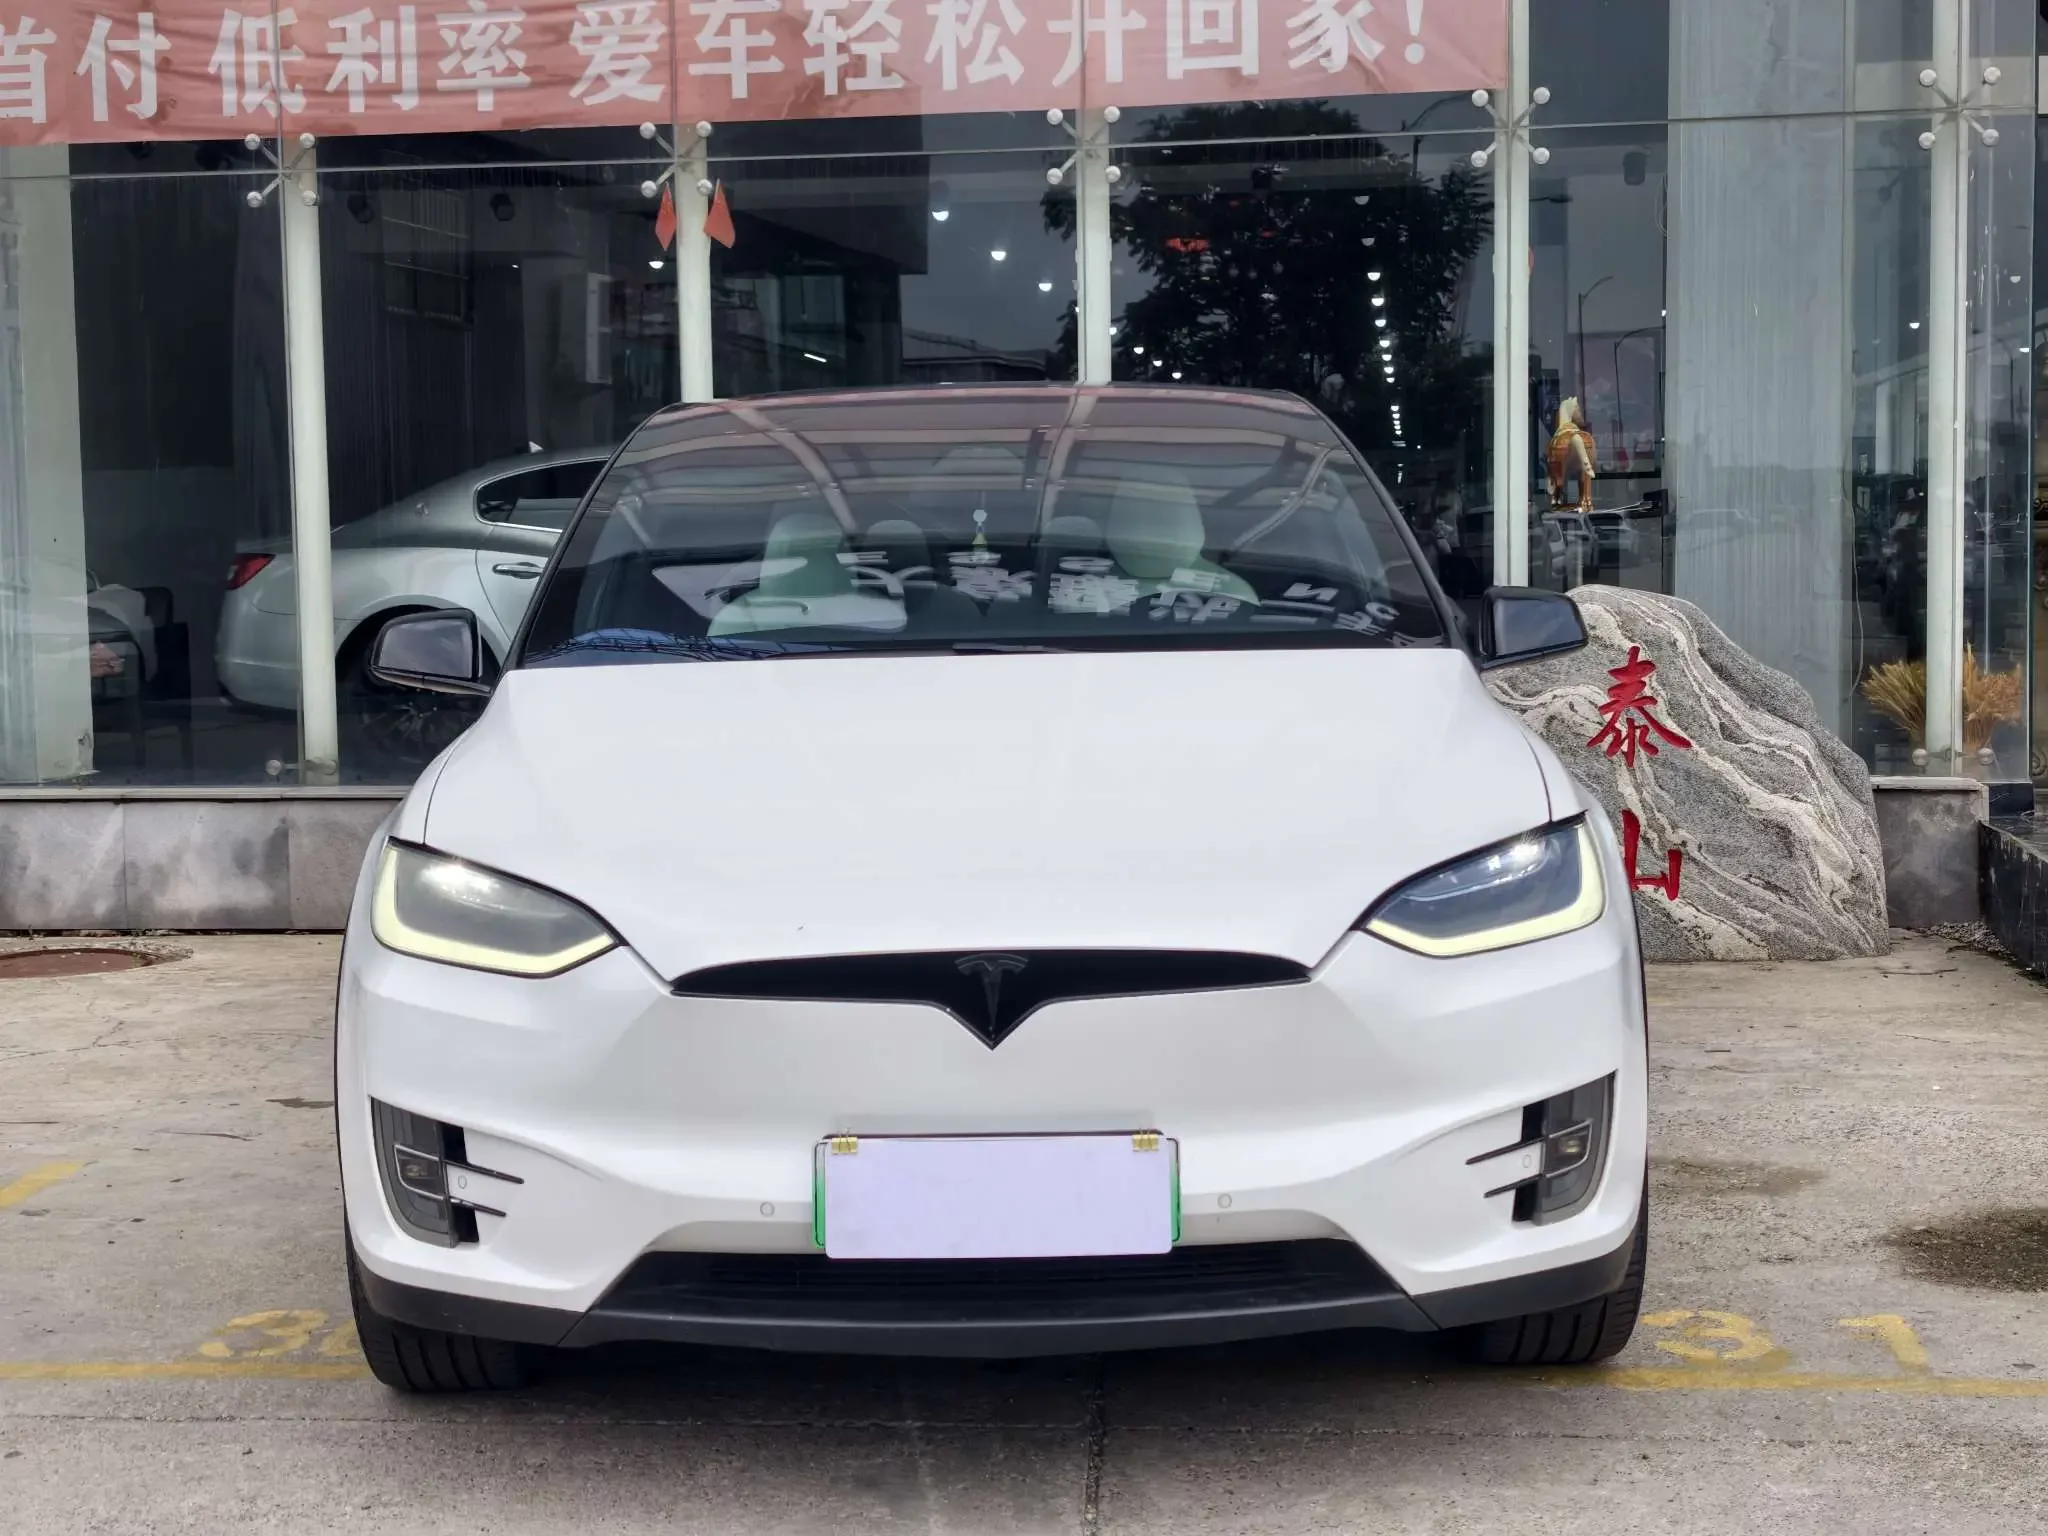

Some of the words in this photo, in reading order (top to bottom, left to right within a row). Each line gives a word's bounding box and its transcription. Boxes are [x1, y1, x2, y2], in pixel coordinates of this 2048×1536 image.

[207, 1, 532, 118] 低利率
[1587, 645, 1692, 901] 泰山
